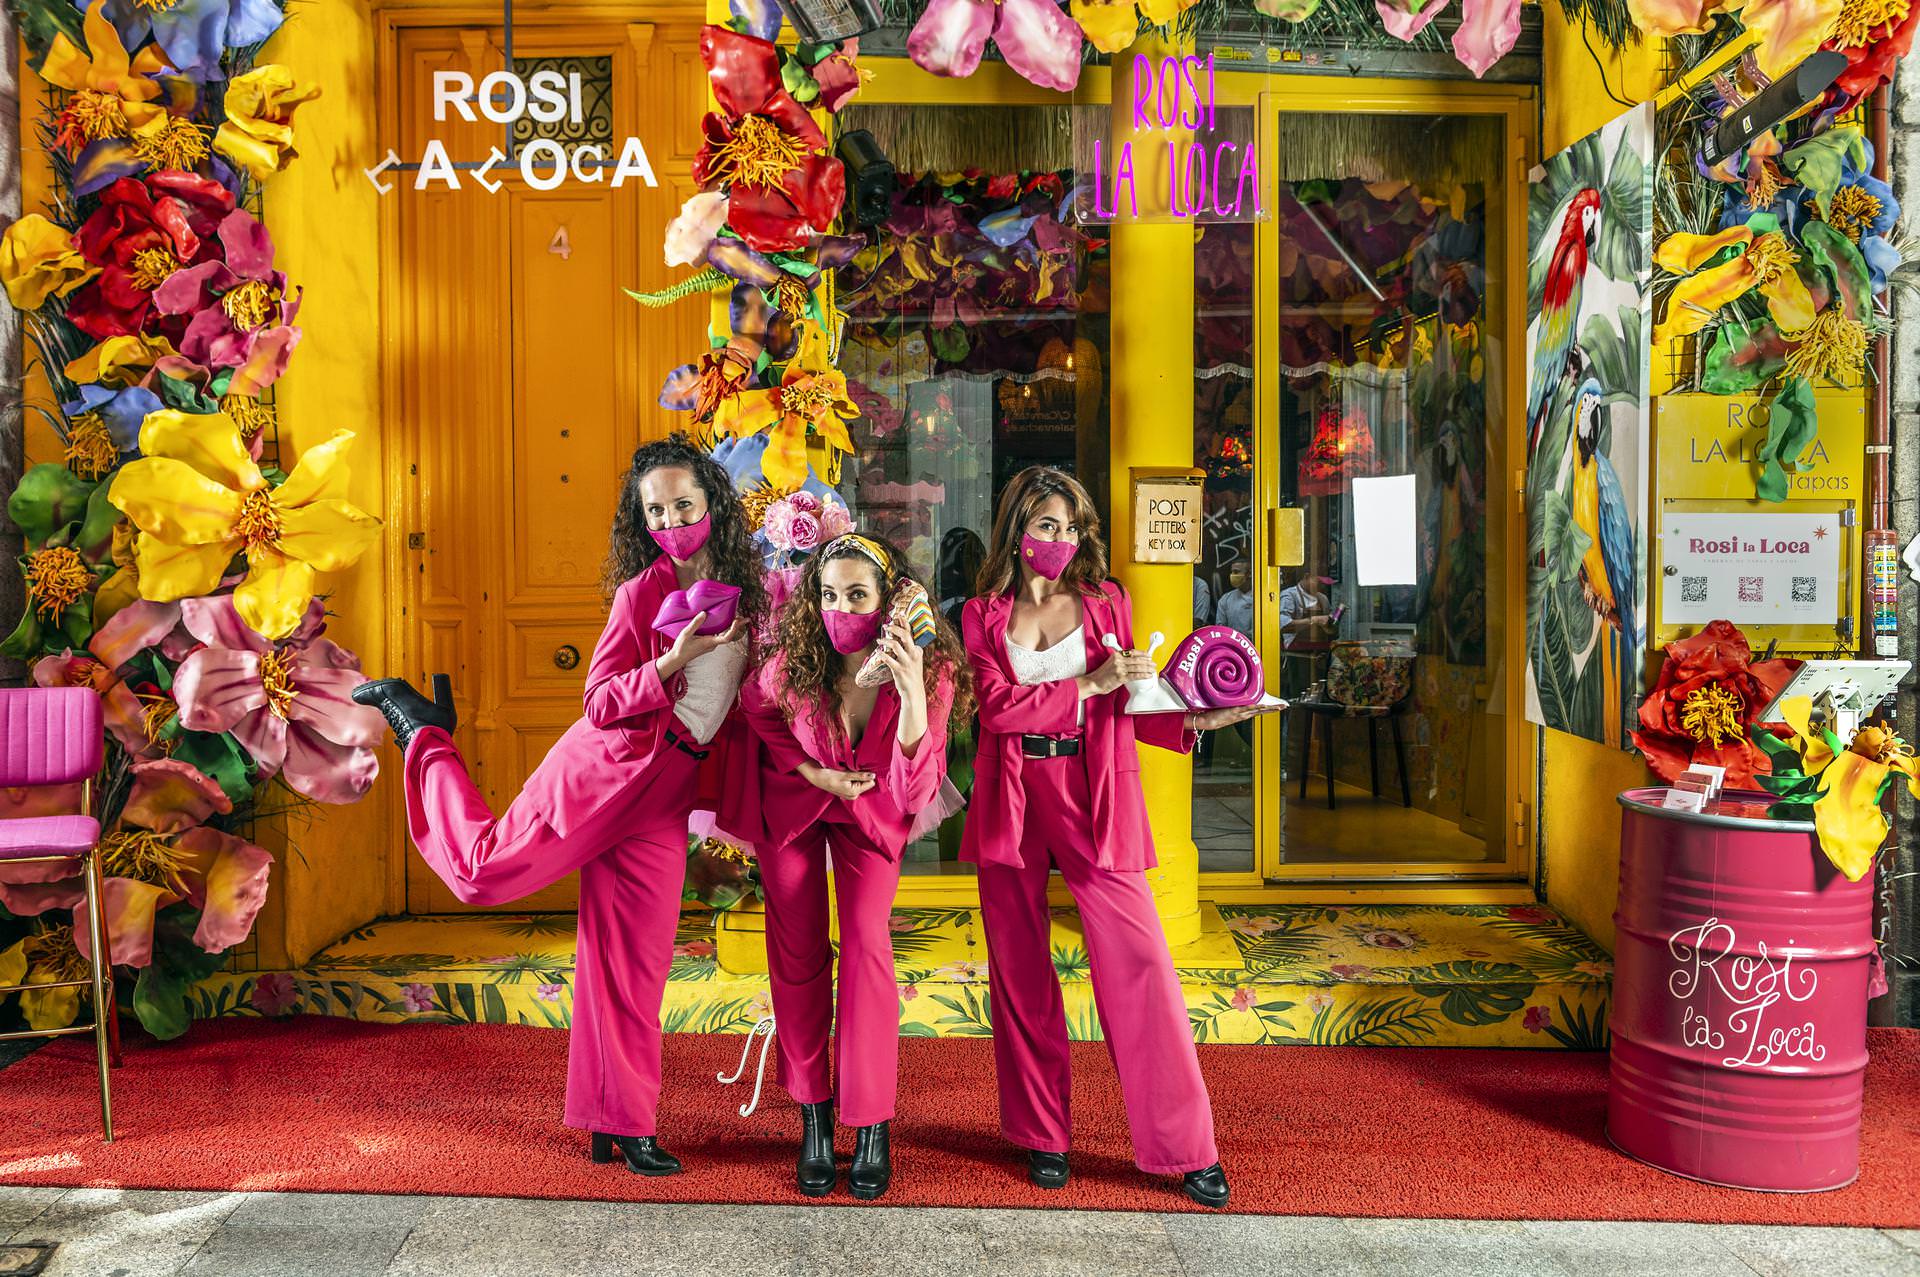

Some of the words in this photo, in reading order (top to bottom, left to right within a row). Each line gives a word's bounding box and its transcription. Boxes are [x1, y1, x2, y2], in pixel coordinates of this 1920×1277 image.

[433, 70, 583, 123] ROSI
[1133, 53, 1215, 131] ROSI
[364, 139, 462, 196] LA
[1095, 140, 1138, 218] LA
[1169, 141, 1261, 218] LOCA
[549, 225, 572, 259] 4
[1691, 438, 1728, 464] LA
[1787, 472, 1849, 495] Tapas
[1148, 520, 1186, 534] LETTERS
[1149, 499, 1187, 516] POST
[1148, 539, 1165, 550] KEY
[1168, 539, 1186, 550] BOX
[1689, 536, 1738, 554] Rosi
[1743, 542, 1755, 552] la
[1760, 538, 1810, 554] Loca
[1178, 635, 1205, 675] Rosi
[1230, 630, 1260, 666] Loca
[1668, 917, 1818, 1004] Rosi
[1681, 1006, 1724, 1050] la
[1722, 992, 1826, 1067] Loca
